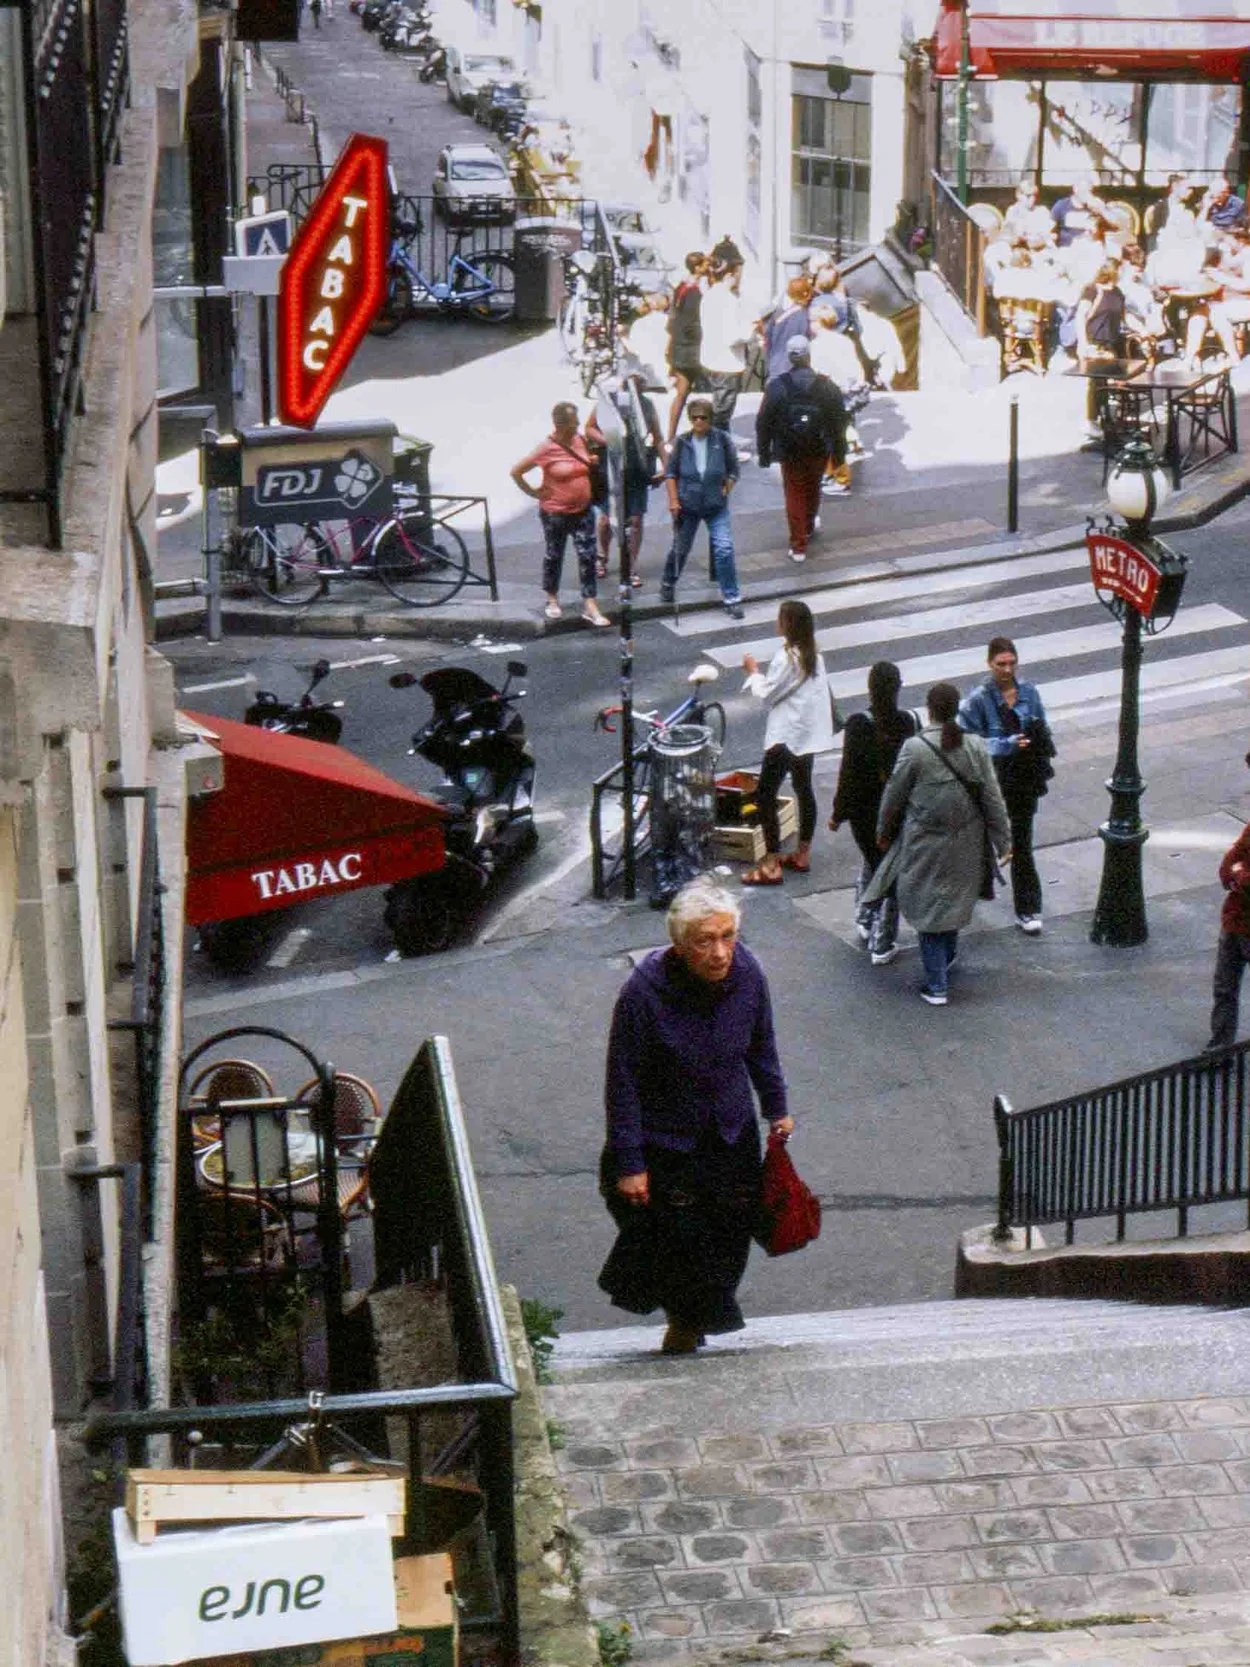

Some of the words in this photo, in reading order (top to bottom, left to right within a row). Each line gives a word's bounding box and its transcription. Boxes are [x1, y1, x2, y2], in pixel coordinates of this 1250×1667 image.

[302, 196, 367, 370] TABAC
[262, 467, 326, 498] FDJ
[1094, 545, 1150, 593] METRO
[251, 853, 362, 899] TABAC
